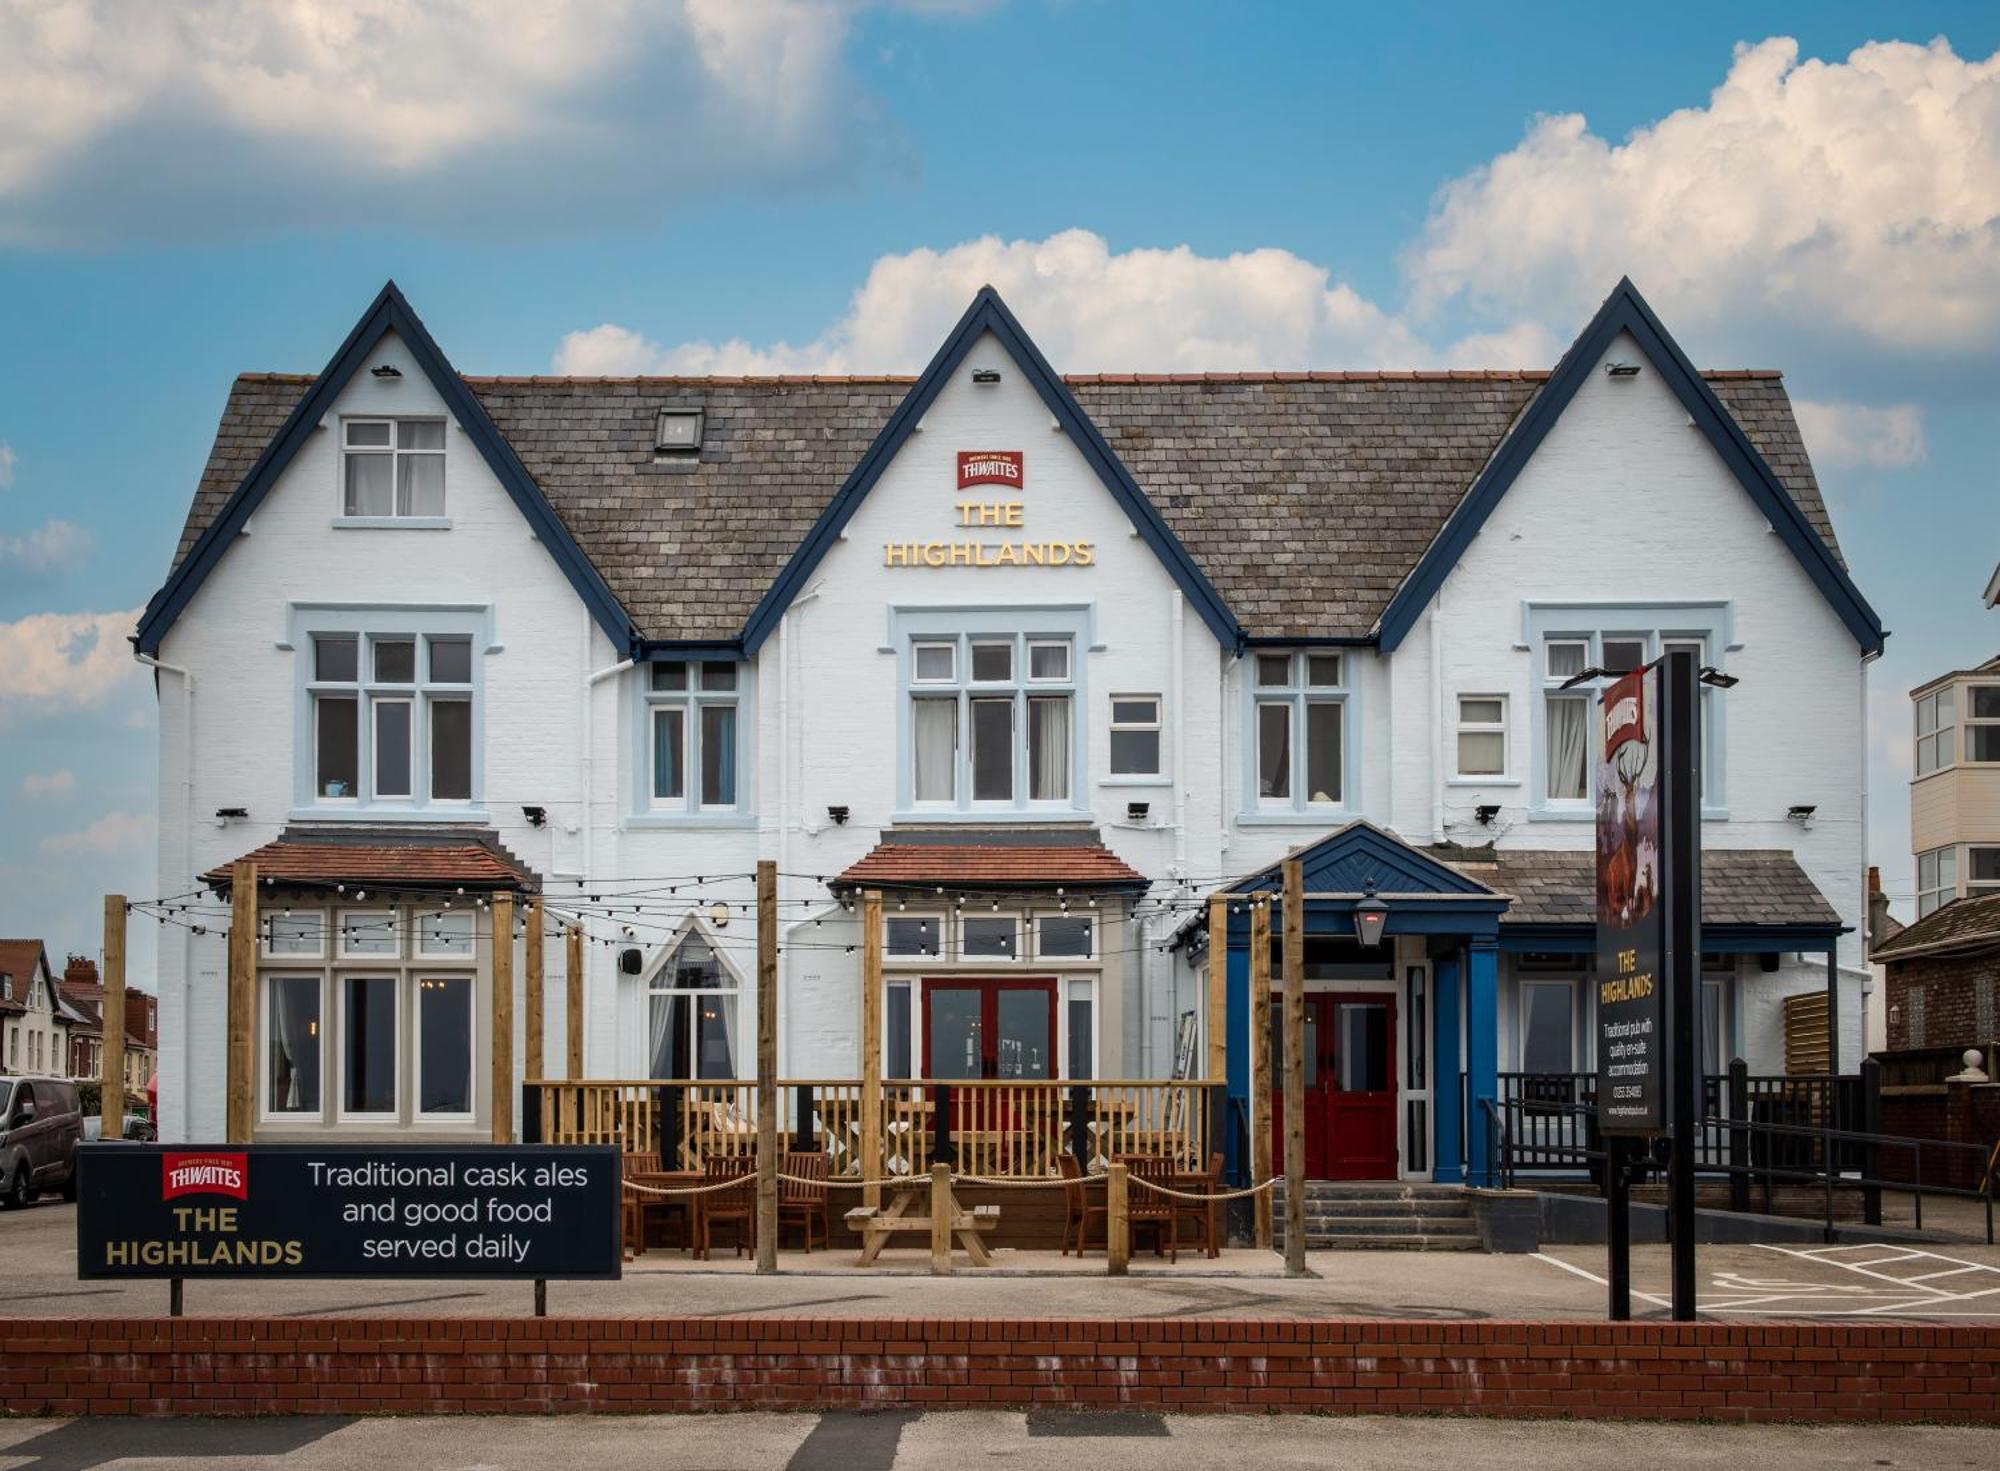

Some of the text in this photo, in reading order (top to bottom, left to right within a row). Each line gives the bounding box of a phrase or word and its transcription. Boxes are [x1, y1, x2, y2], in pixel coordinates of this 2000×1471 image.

[962, 460, 1018, 479] THWAITES
[956, 501, 1024, 527] THE
[885, 541, 1095, 567] HIGHLANDS
[1618, 949, 1636, 974] THE
[1601, 973, 1653, 1004] HIGHLANDS
[1604, 1017, 1653, 1039] Traditional pub with
[1609, 1039, 1647, 1060] quality en-suite
[1608, 1060, 1649, 1077] accommodation
[169, 1165, 241, 1189] THWAITES
[308, 1162, 588, 1187] Traditional cask ales
[173, 1207, 238, 1232] THE
[343, 1198, 552, 1227] and good food
[106, 1240, 303, 1265] HIGHLANDS
[363, 1234, 531, 1263] served daily
